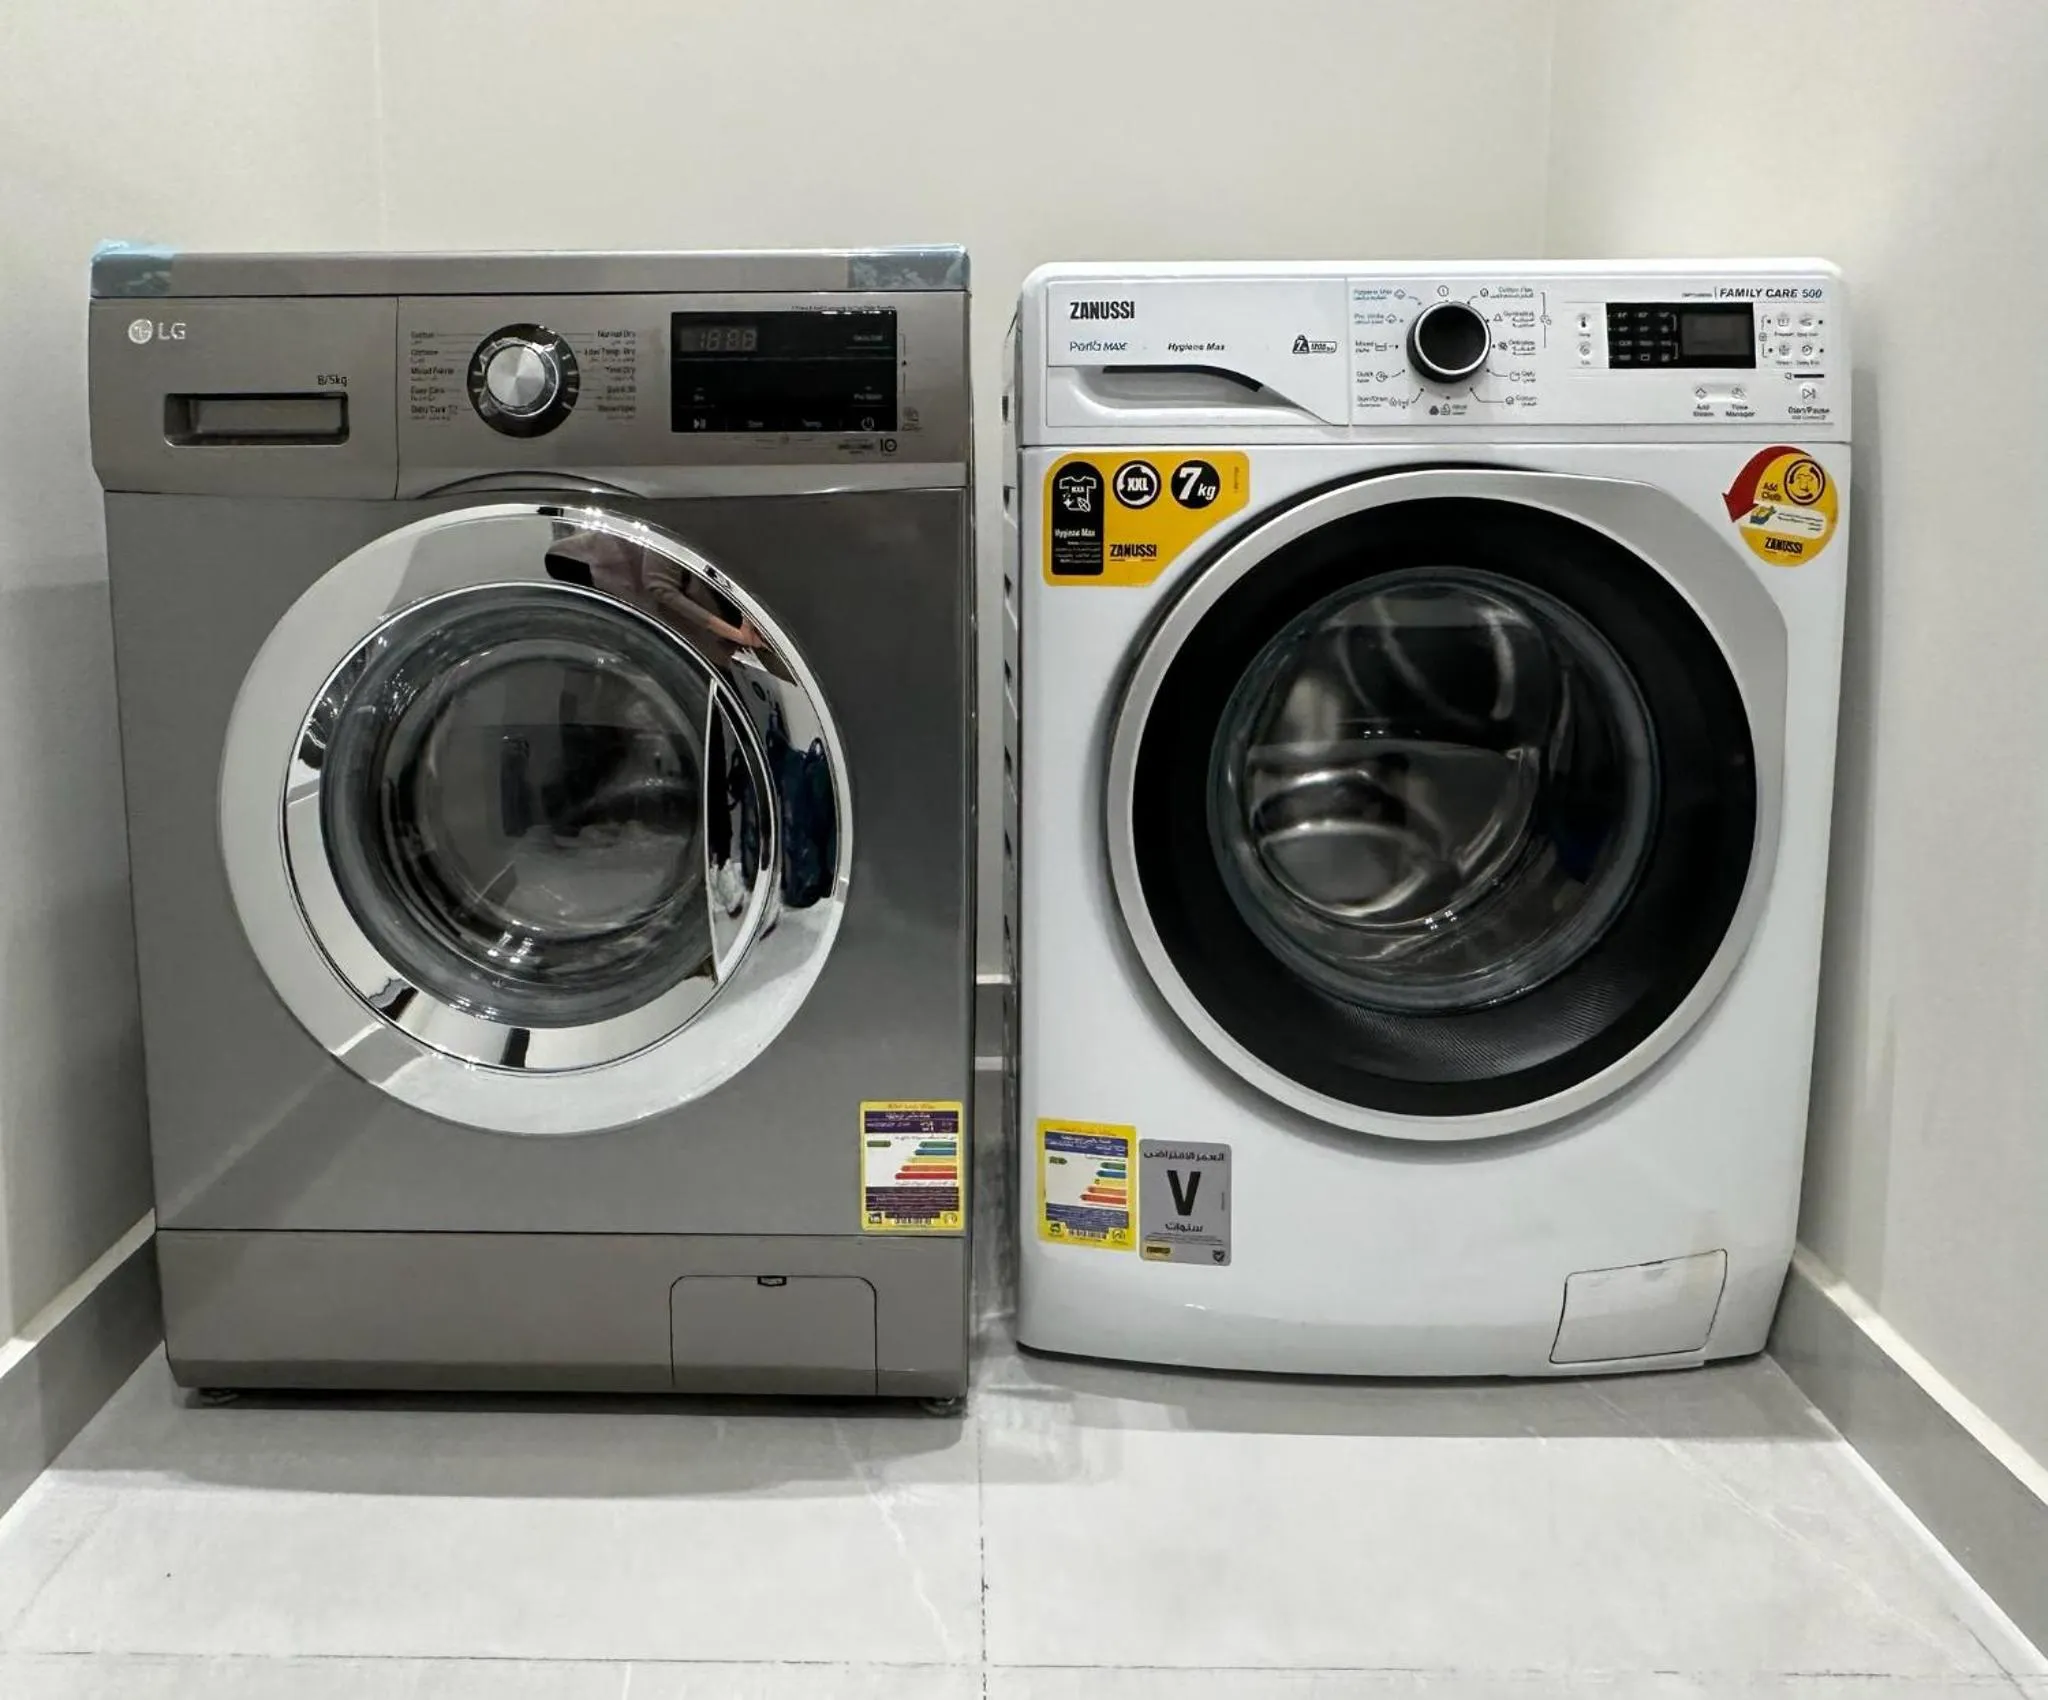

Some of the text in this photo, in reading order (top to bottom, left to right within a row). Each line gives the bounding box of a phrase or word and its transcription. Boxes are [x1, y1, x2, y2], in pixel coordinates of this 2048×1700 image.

[1719, 288, 1763, 299] FAMILY
[1765, 288, 1799, 299] CARE
[1802, 288, 1823, 298] 500
[1070, 301, 1135, 319] ZANUSSI
[157, 322, 187, 340] LG
[1168, 342, 1225, 353] Hygiene Max
[1127, 477, 1149, 491] XXL
[1178, 466, 1216, 500] 7 kg
[1110, 544, 1158, 558] ZANUSSI
[1765, 536, 1803, 555] ZANUSSI
